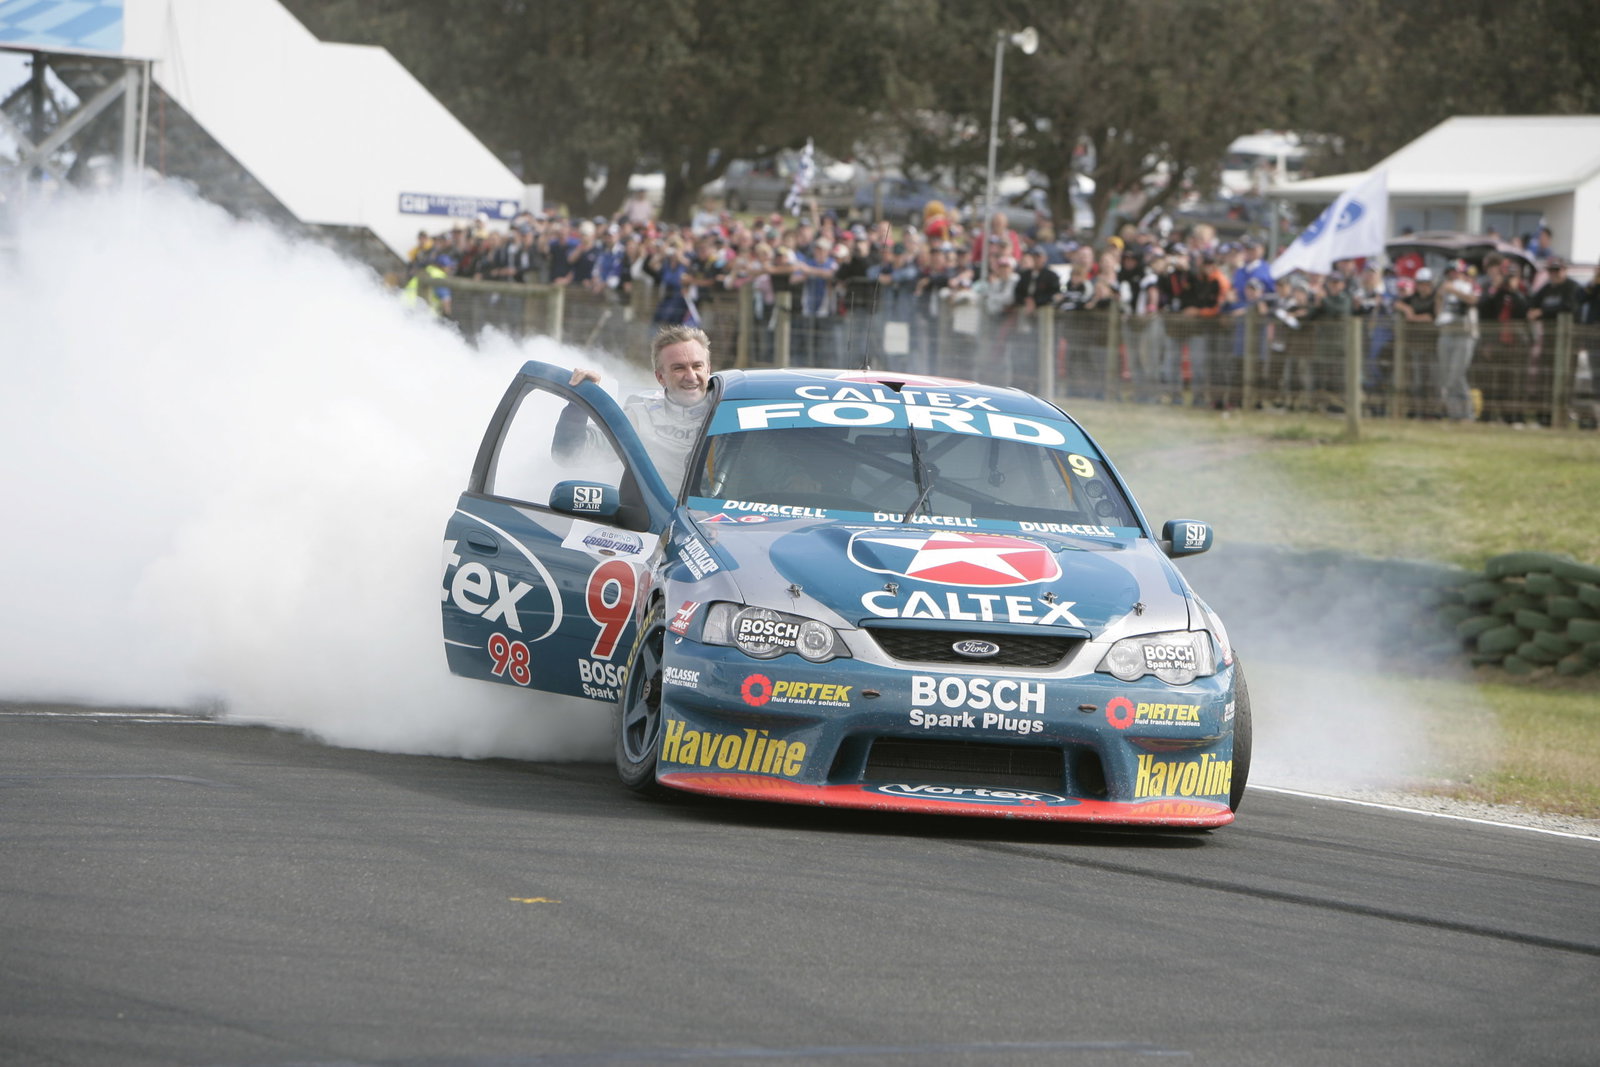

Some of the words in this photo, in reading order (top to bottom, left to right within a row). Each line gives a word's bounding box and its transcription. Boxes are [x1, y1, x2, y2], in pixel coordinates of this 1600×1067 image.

[795, 385, 1000, 411] CALTEX
[736, 401, 1066, 446] FORD
[1067, 454, 1096, 478] 9
[574, 487, 601, 502] SP
[722, 500, 826, 518] DURACELL
[1018, 521, 1115, 537] DURACELL
[1187, 525, 1206, 540] SP
[582, 535, 613, 551] GRAND
[684, 538, 719, 575] DUNLOP
[585, 559, 637, 661] 9
[860, 590, 1086, 628] CALTEX
[740, 619, 800, 638] BOSCH
[738, 633, 765, 644] Spark
[769, 635, 796, 647] Plugs
[962, 641, 989, 654] Ford
[488, 632, 532, 686] 98
[1144, 646, 1195, 661] BOSCH
[1146, 660, 1173, 670] Spark
[1174, 660, 1196, 670] Plugs
[671, 667, 700, 683] CLASSIC
[583, 683, 616, 699] Spark
[772, 681, 853, 702] PIRTEK
[911, 676, 1046, 713] BOSCH
[771, 696, 787, 704] fluid
[788, 697, 817, 706] transfer
[818, 700, 851, 708] solutions
[909, 709, 976, 729] Spark
[982, 712, 1044, 735] Plugs
[1134, 703, 1201, 722] PIRTEK
[661, 719, 807, 777] Havoline
[1134, 752, 1233, 798] Havoline
[895, 783, 1044, 801] Vortex
